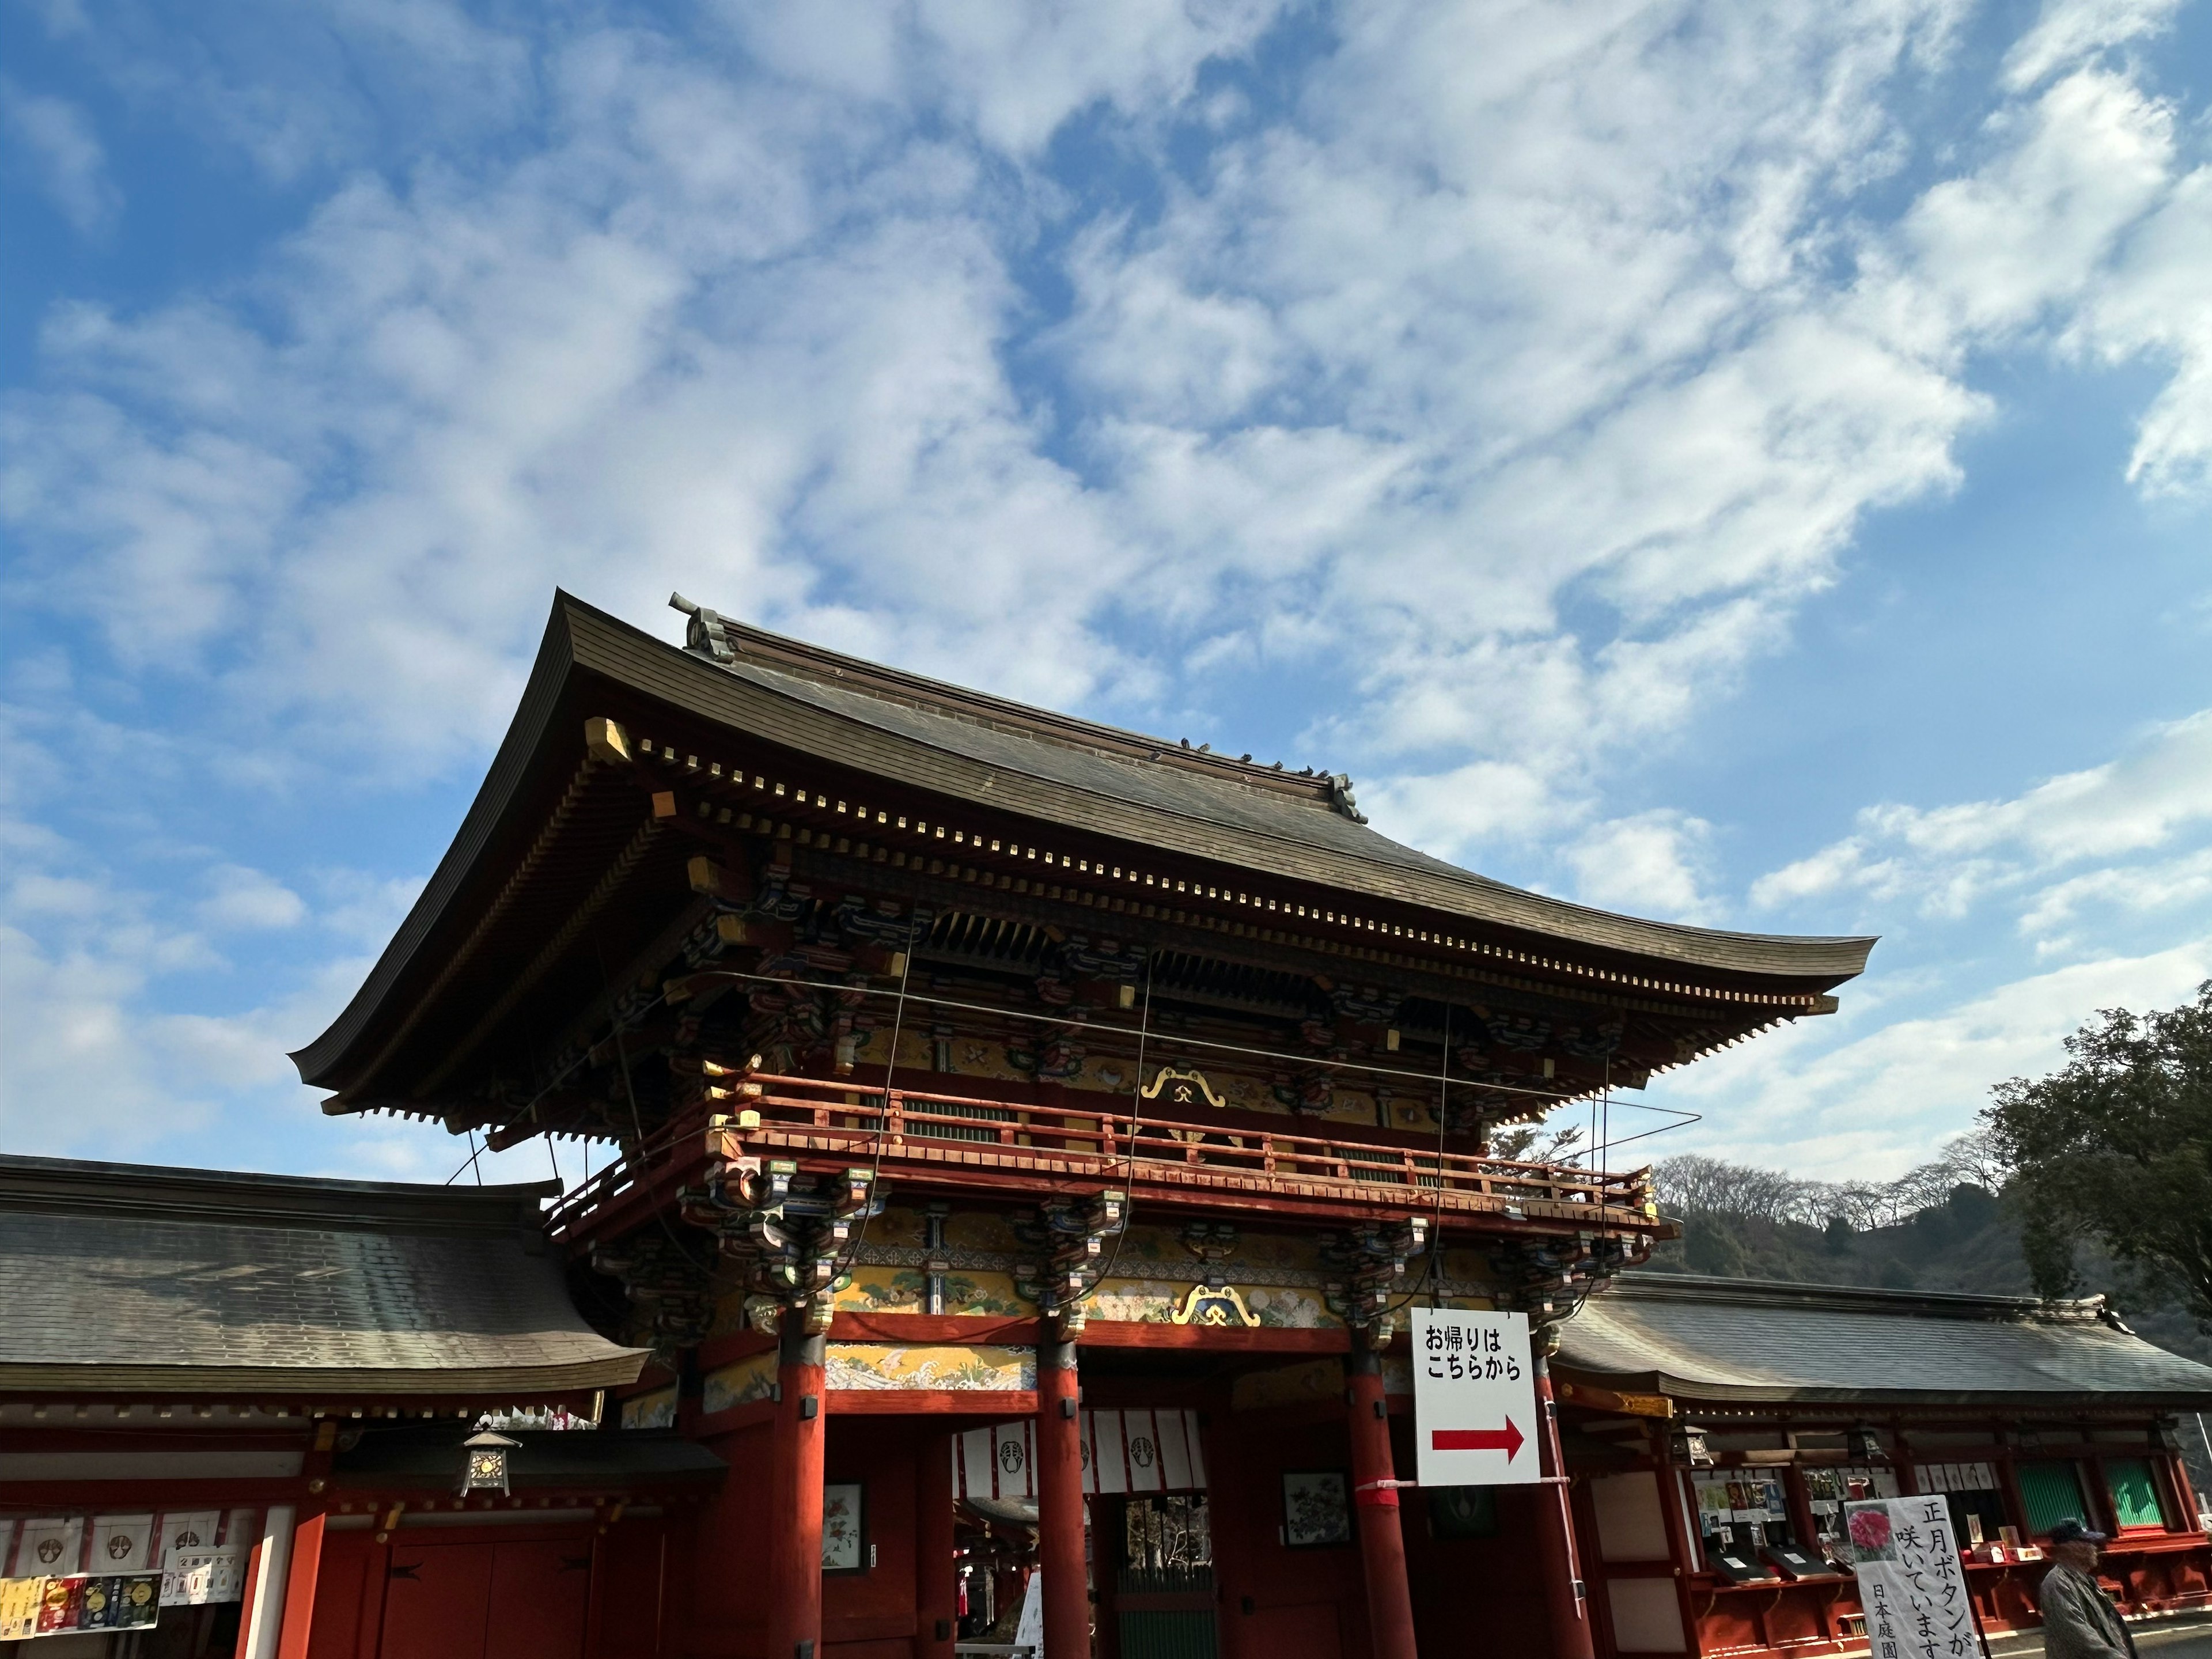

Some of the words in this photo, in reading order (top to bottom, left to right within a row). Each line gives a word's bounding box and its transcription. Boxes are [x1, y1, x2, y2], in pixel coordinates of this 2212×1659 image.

[1426, 1325, 1501, 1352] お帰りは
[1428, 1354, 1520, 1381] こちらから
[1896, 1525, 1940, 1659] 咲いています
[1923, 1502, 1972, 1657] 正月ボタンが
[1873, 1584, 1897, 1659] 日本庭園
